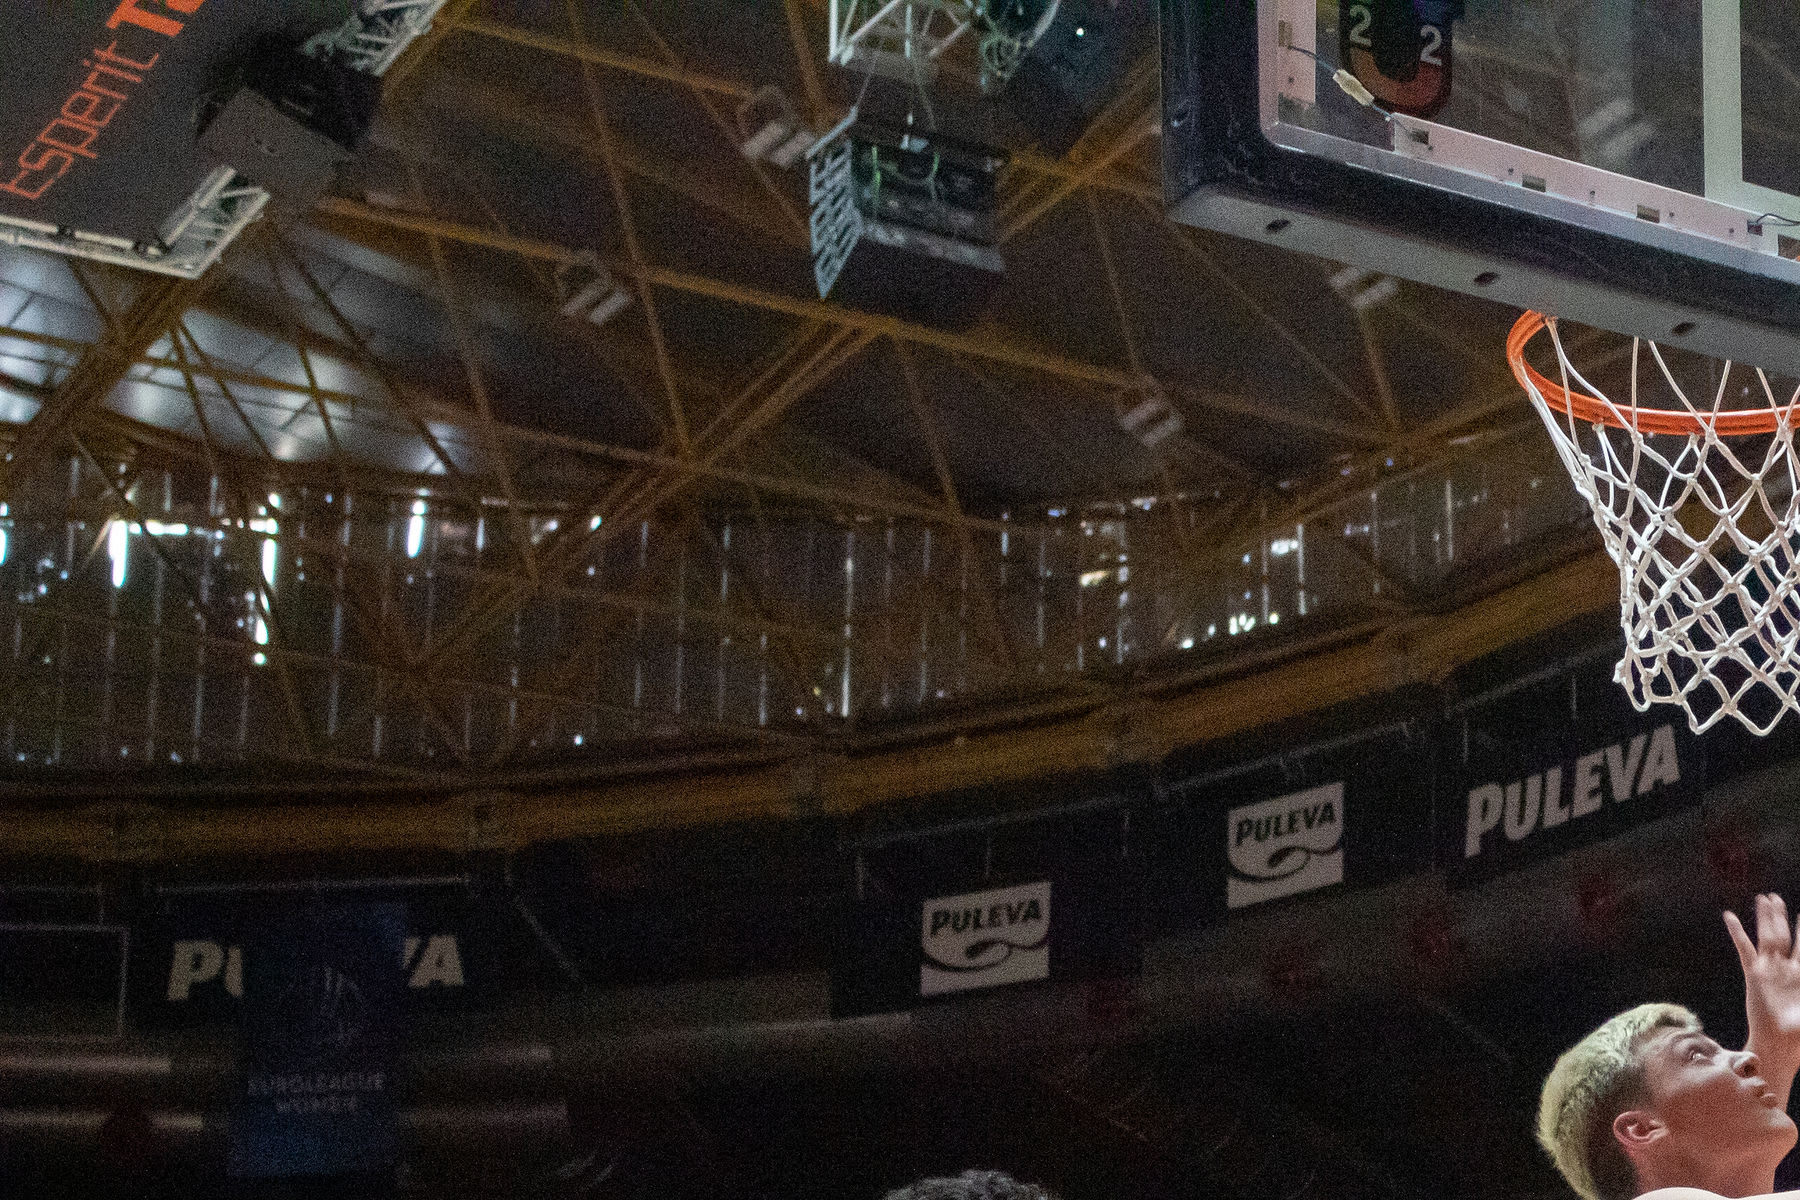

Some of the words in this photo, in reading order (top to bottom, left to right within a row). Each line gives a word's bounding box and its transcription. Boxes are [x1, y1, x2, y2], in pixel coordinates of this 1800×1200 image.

[1464, 724, 1680, 858] PULEVA
[1236, 804, 1337, 848] PULEVA
[930, 897, 1043, 936] PULEVA
